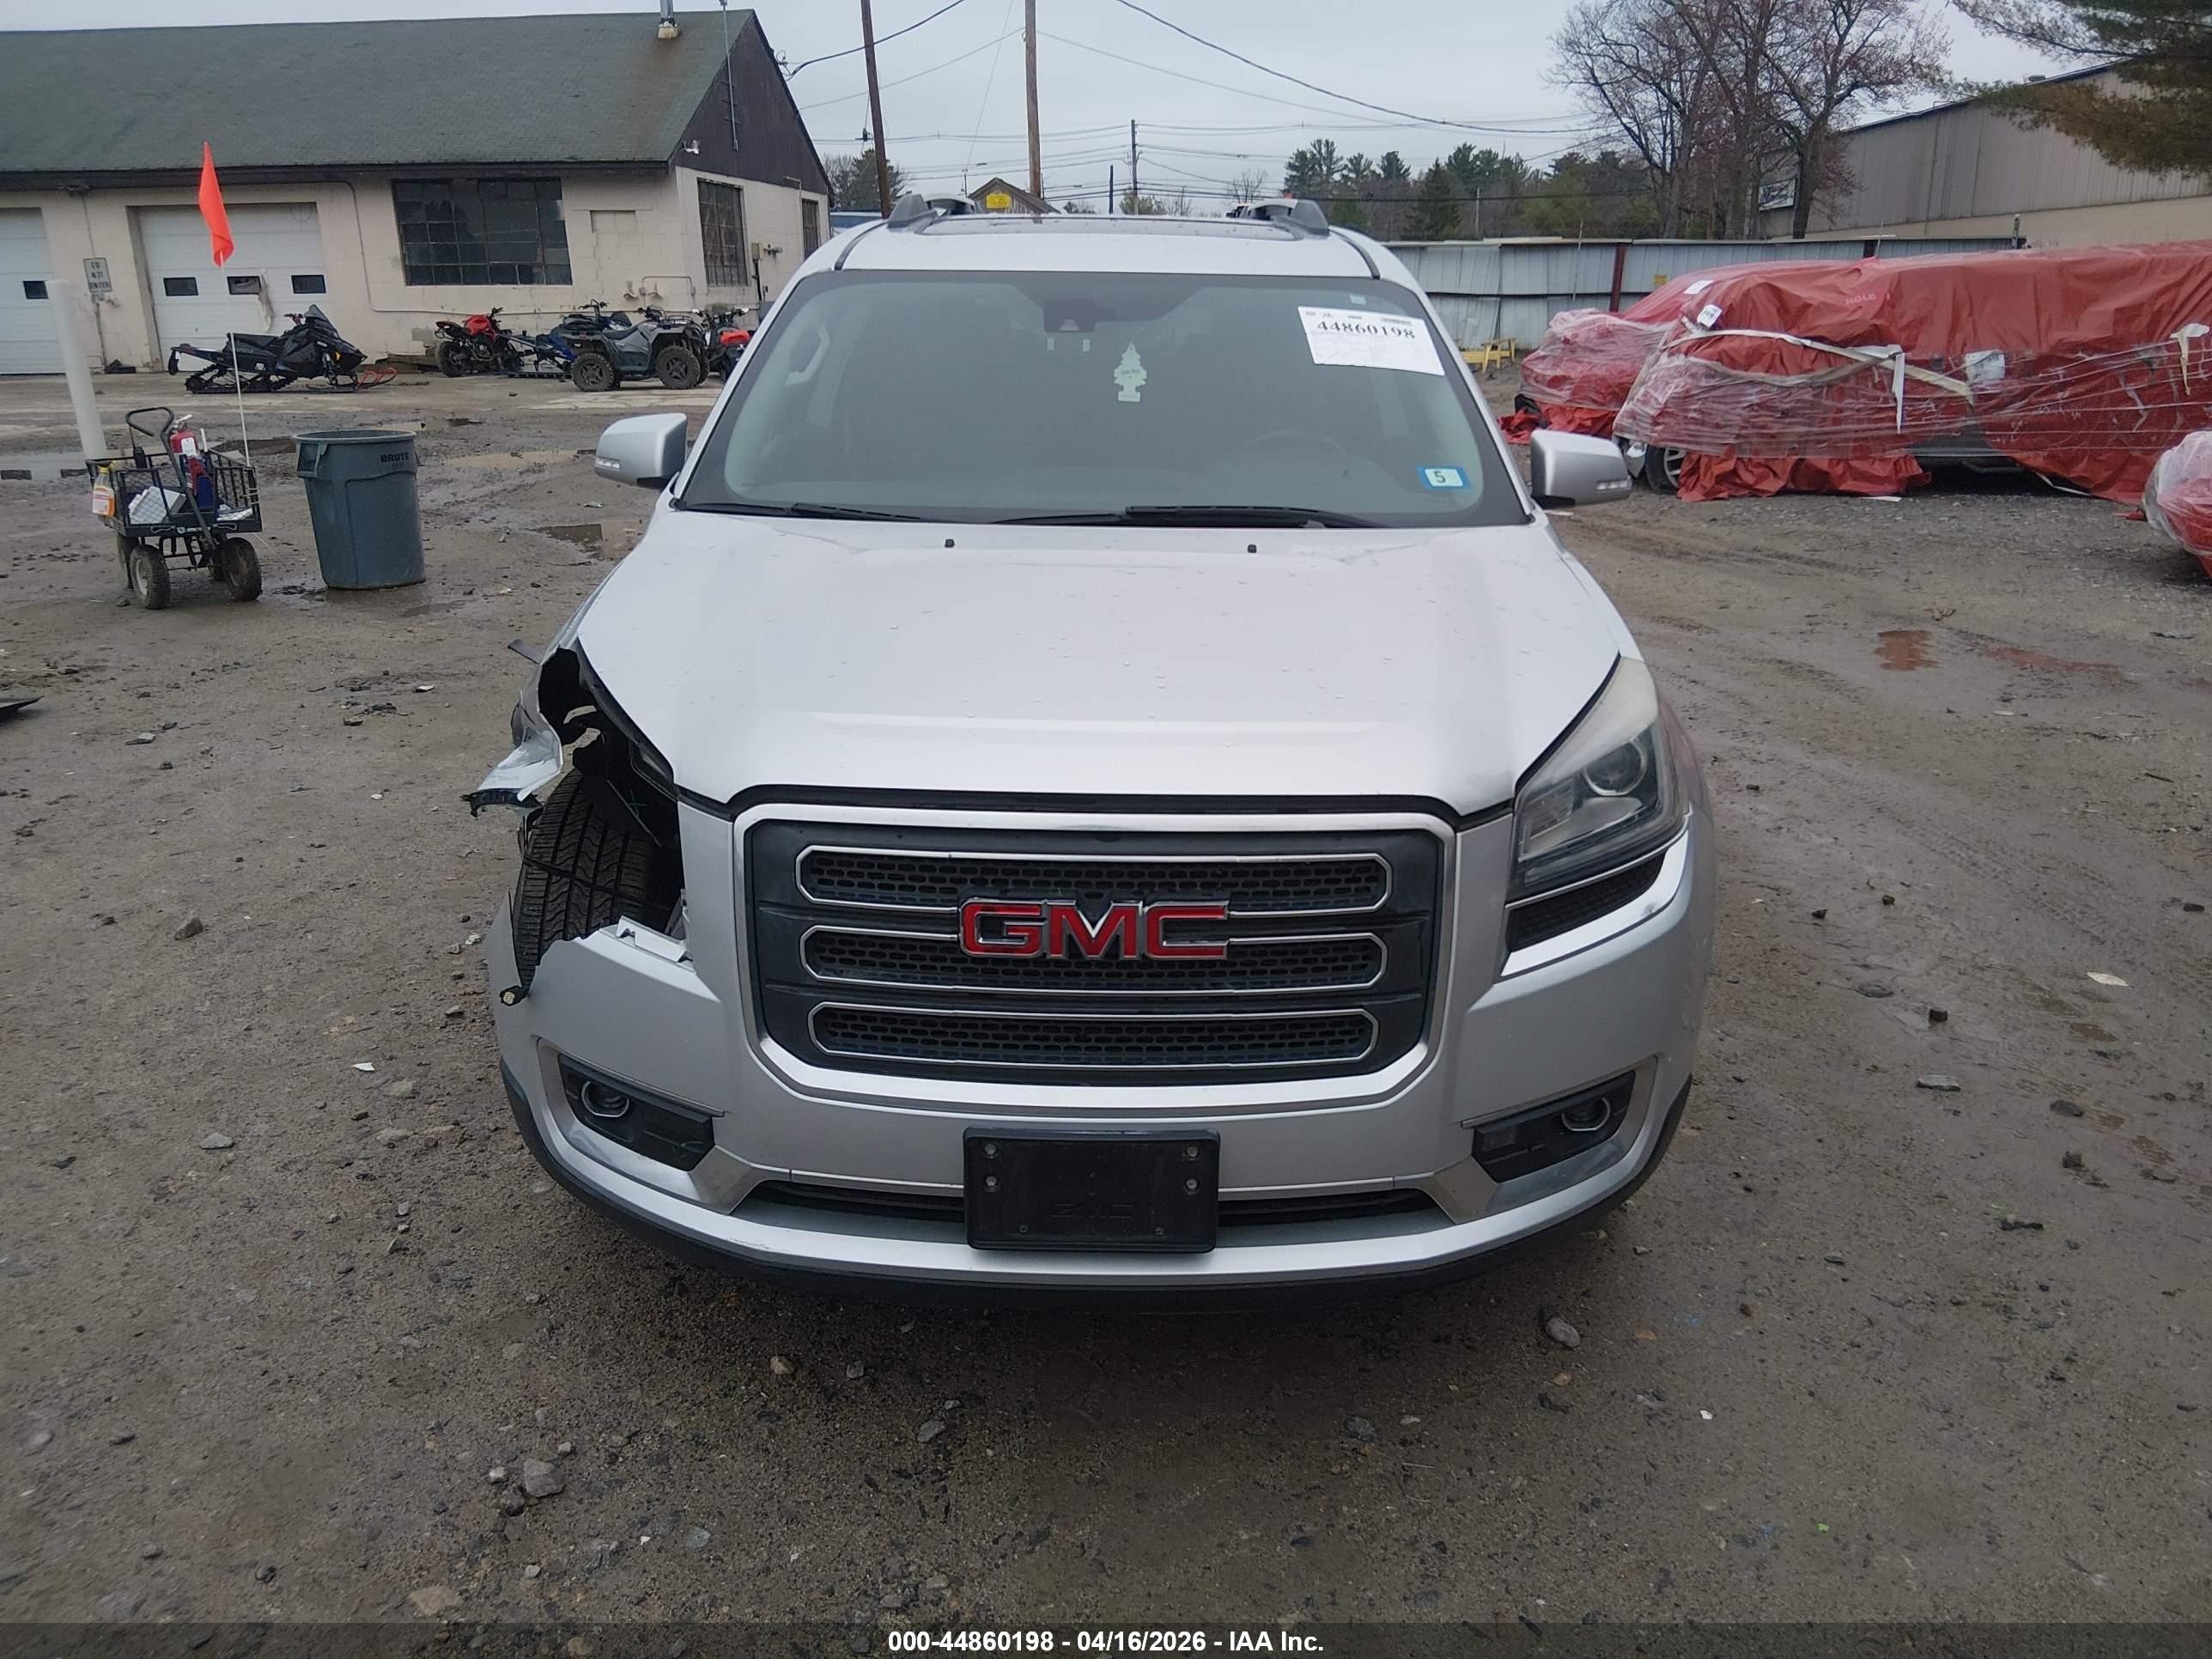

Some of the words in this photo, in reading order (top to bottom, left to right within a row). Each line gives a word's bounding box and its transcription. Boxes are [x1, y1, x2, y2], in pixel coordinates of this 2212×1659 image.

[1317, 320, 1415, 340] 44860198
[380, 452, 410, 463] BRUTE
[1433, 471, 1446, 483] 5
[960, 897, 1230, 960] GMC
